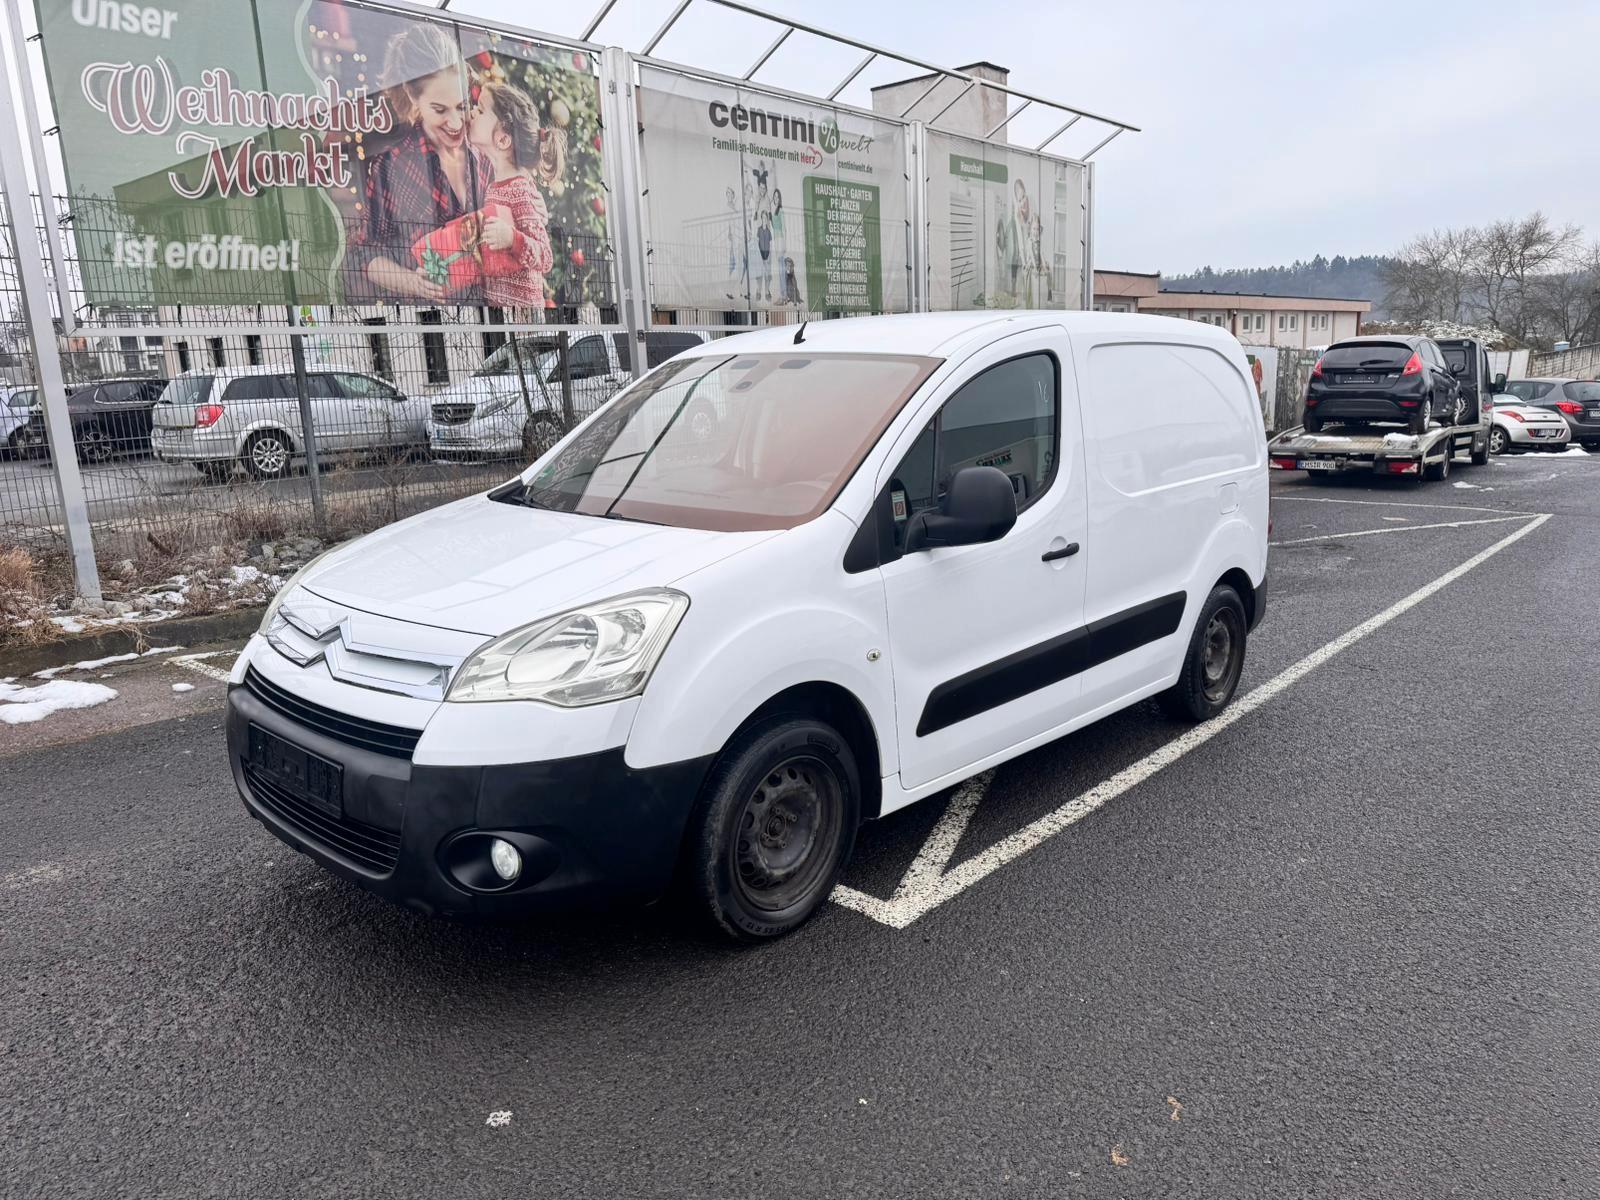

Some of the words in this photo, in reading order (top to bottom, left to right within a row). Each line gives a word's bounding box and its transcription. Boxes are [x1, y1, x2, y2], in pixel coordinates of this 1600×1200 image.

[71, 0, 178, 40] Unser
[81, 56, 394, 135] Weihnachts
[712, 136, 787, 162] Familien-Discounter
[788, 150, 800, 162] mit
[800, 151, 817, 166] Herz
[839, 134, 875, 154] welt
[168, 131, 352, 199] Markt
[815, 183, 847, 198] HAUSHALT
[850, 188, 873, 202] GARTEN
[830, 198, 860, 211] PFLANZEN
[827, 210, 864, 224] DEKORATION
[828, 222, 863, 236] GESCHENKE
[112, 233, 159, 270] ist
[165, 234, 300, 272] eröffnet!
